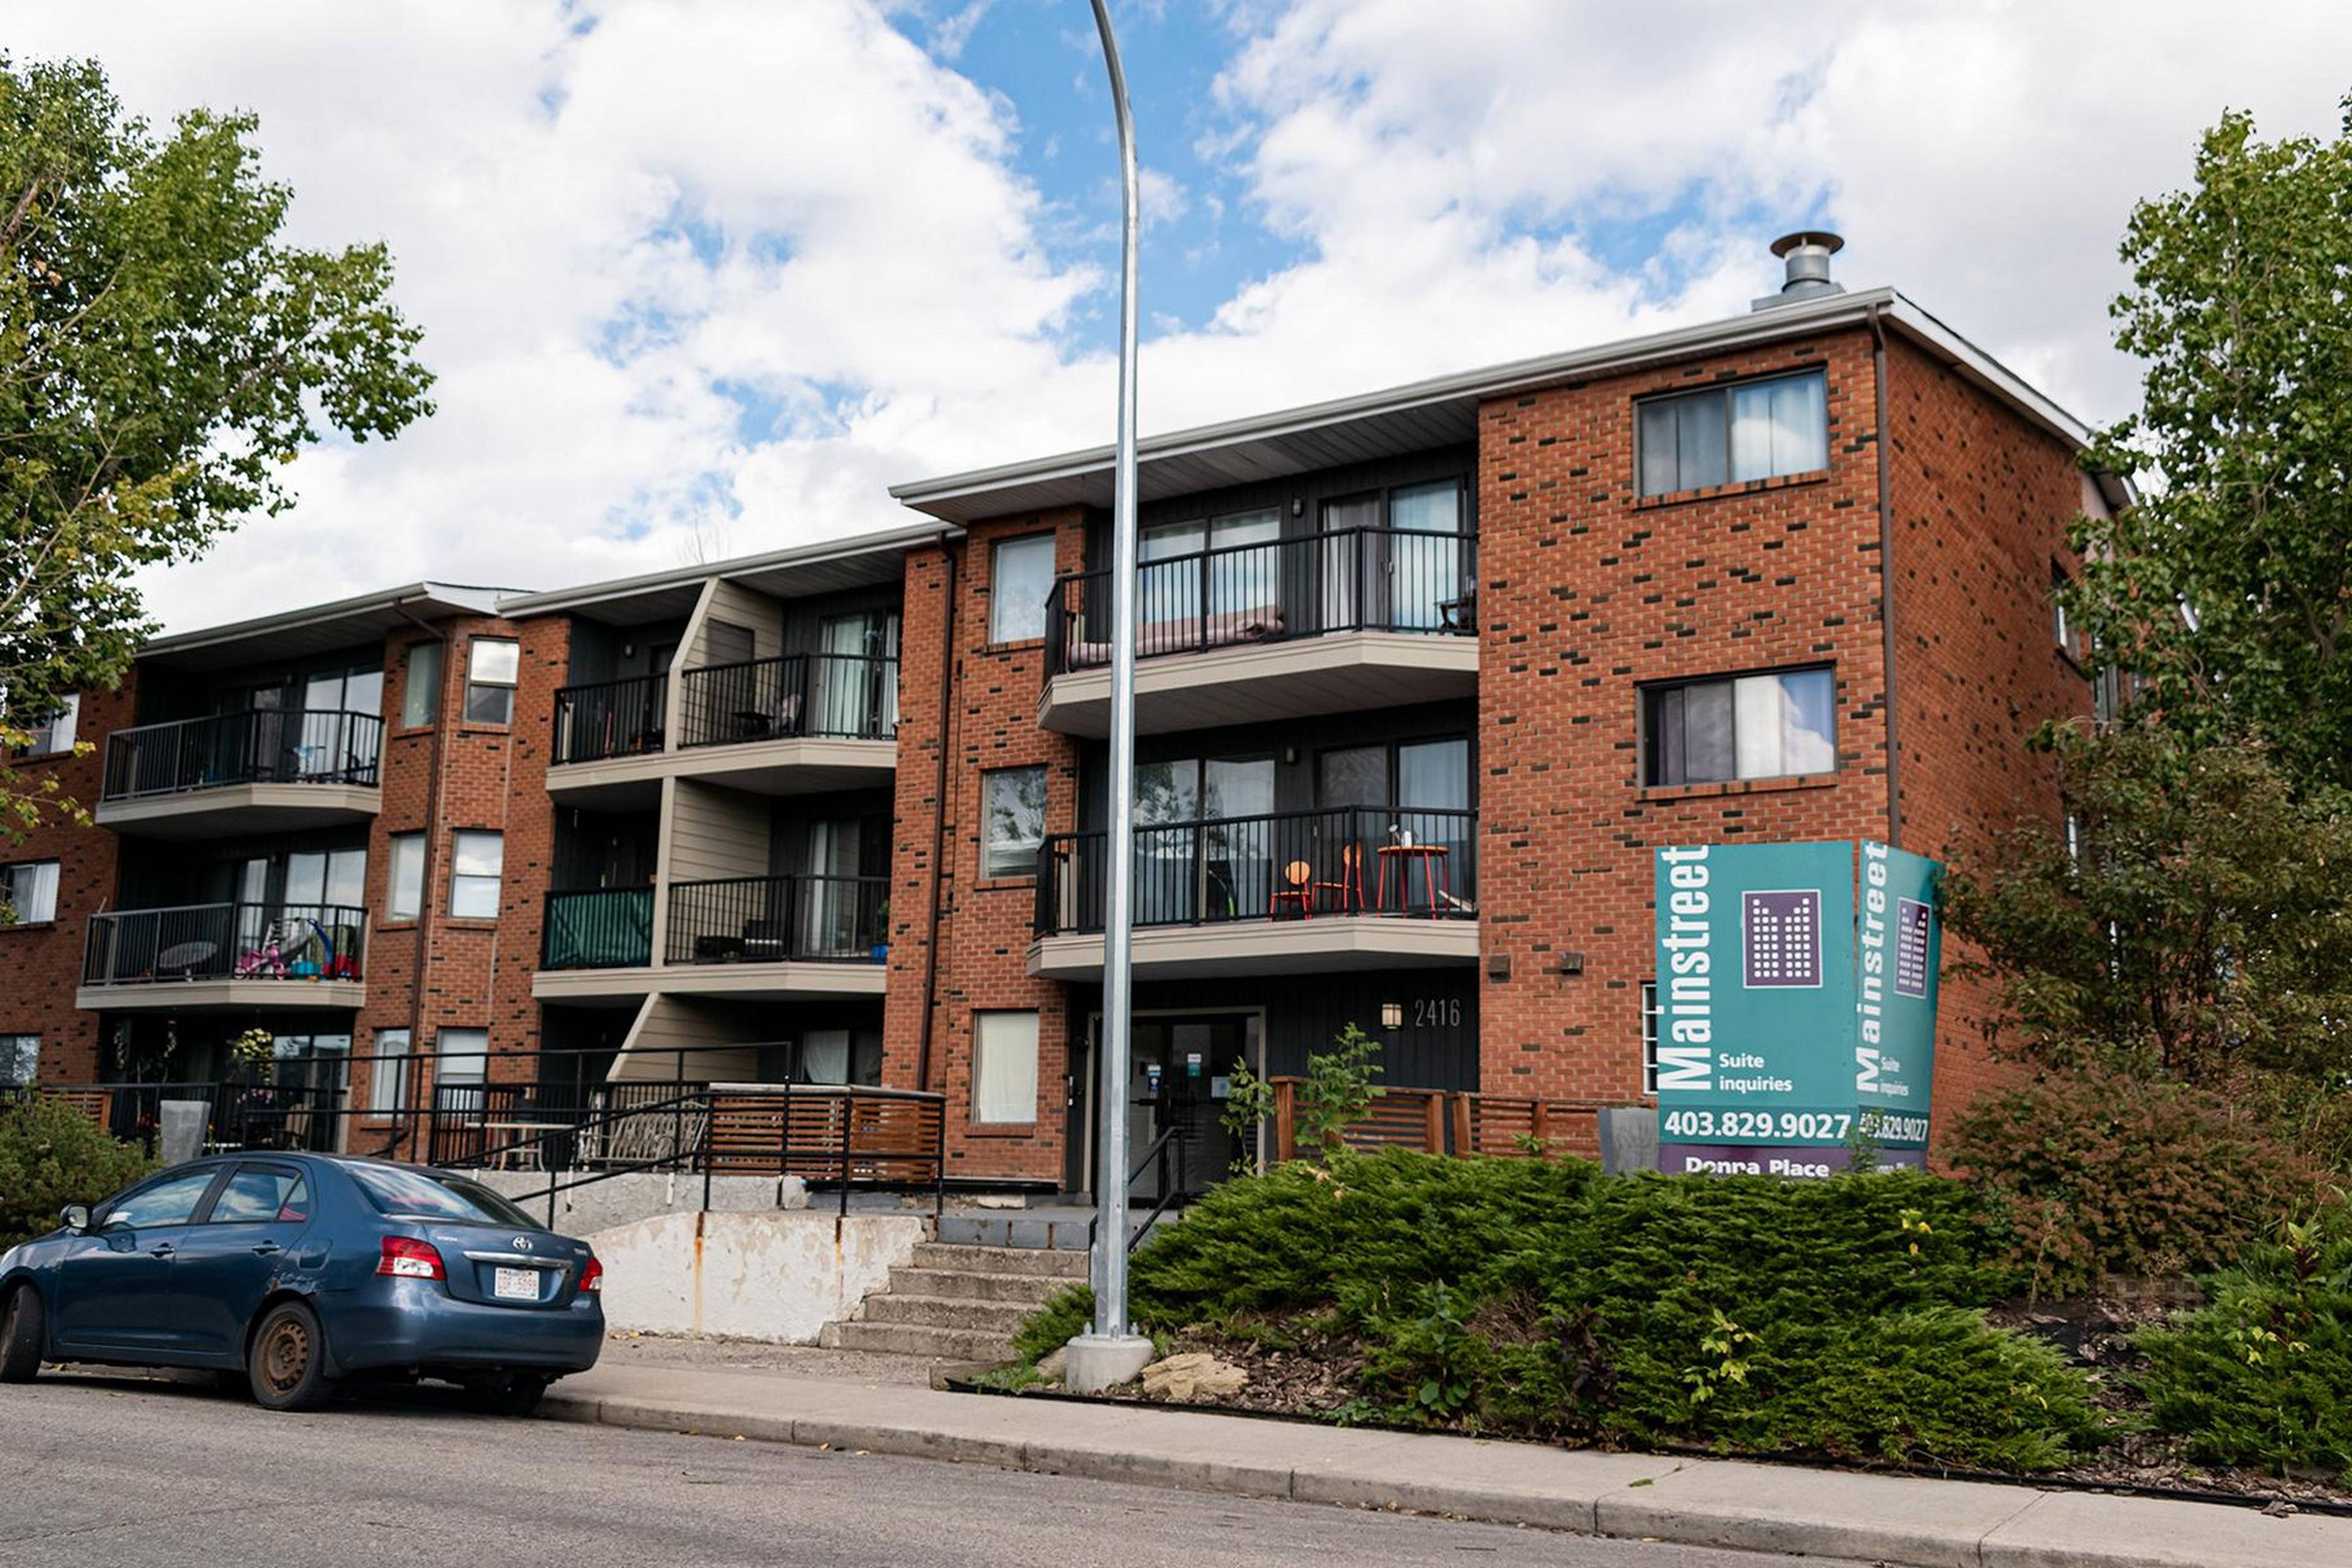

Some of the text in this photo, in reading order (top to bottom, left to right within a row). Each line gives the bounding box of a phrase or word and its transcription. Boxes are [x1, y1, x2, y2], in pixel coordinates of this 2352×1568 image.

[1656, 845, 1711, 1090] Mainstreet
[1856, 841, 1888, 1092] Mainstreet
[1415, 998, 1460, 1027] 2416
[1719, 1053, 1765, 1068] Suite
[1719, 1076, 1793, 1093] inquiries
[1664, 1110, 1852, 1139] 403.829.9027
[1769, 1159, 1830, 1177] Place
